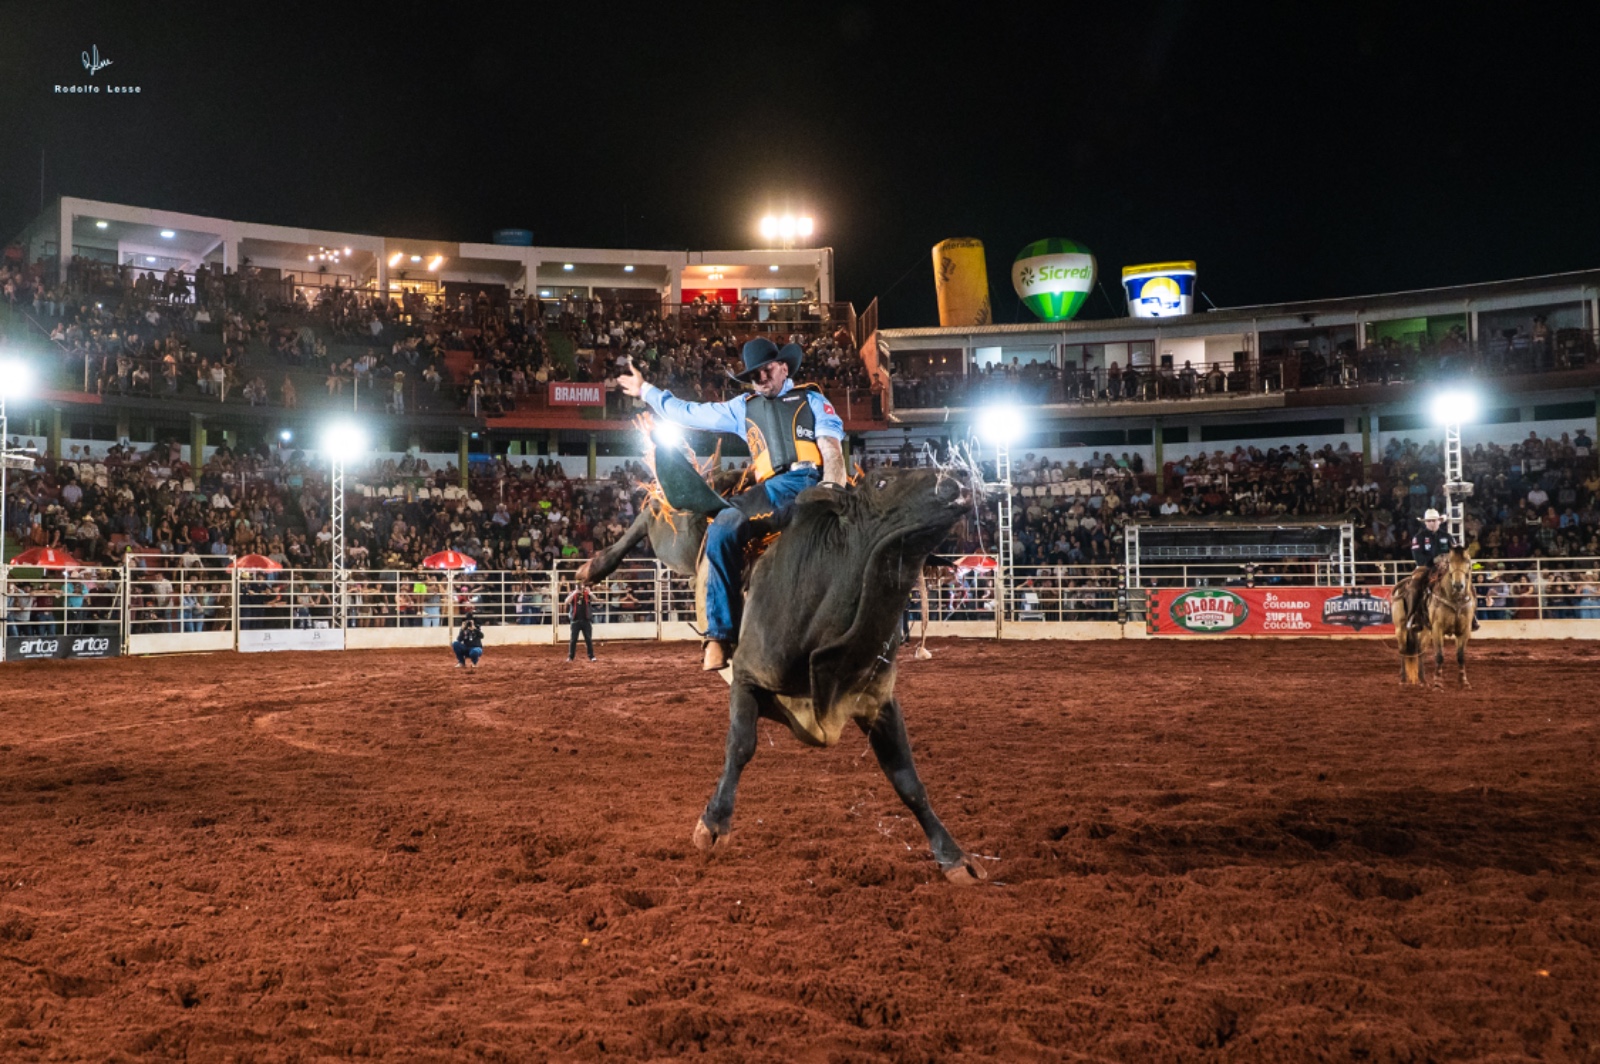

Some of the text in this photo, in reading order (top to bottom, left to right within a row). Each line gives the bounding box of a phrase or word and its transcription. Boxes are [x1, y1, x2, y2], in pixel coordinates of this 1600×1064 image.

[1039, 265, 1092, 282] Sicredi
[554, 387, 600, 402] BRAHMA
[1174, 598, 1244, 618] COLORADO
[1324, 599, 1391, 616] DREAM TEAM
